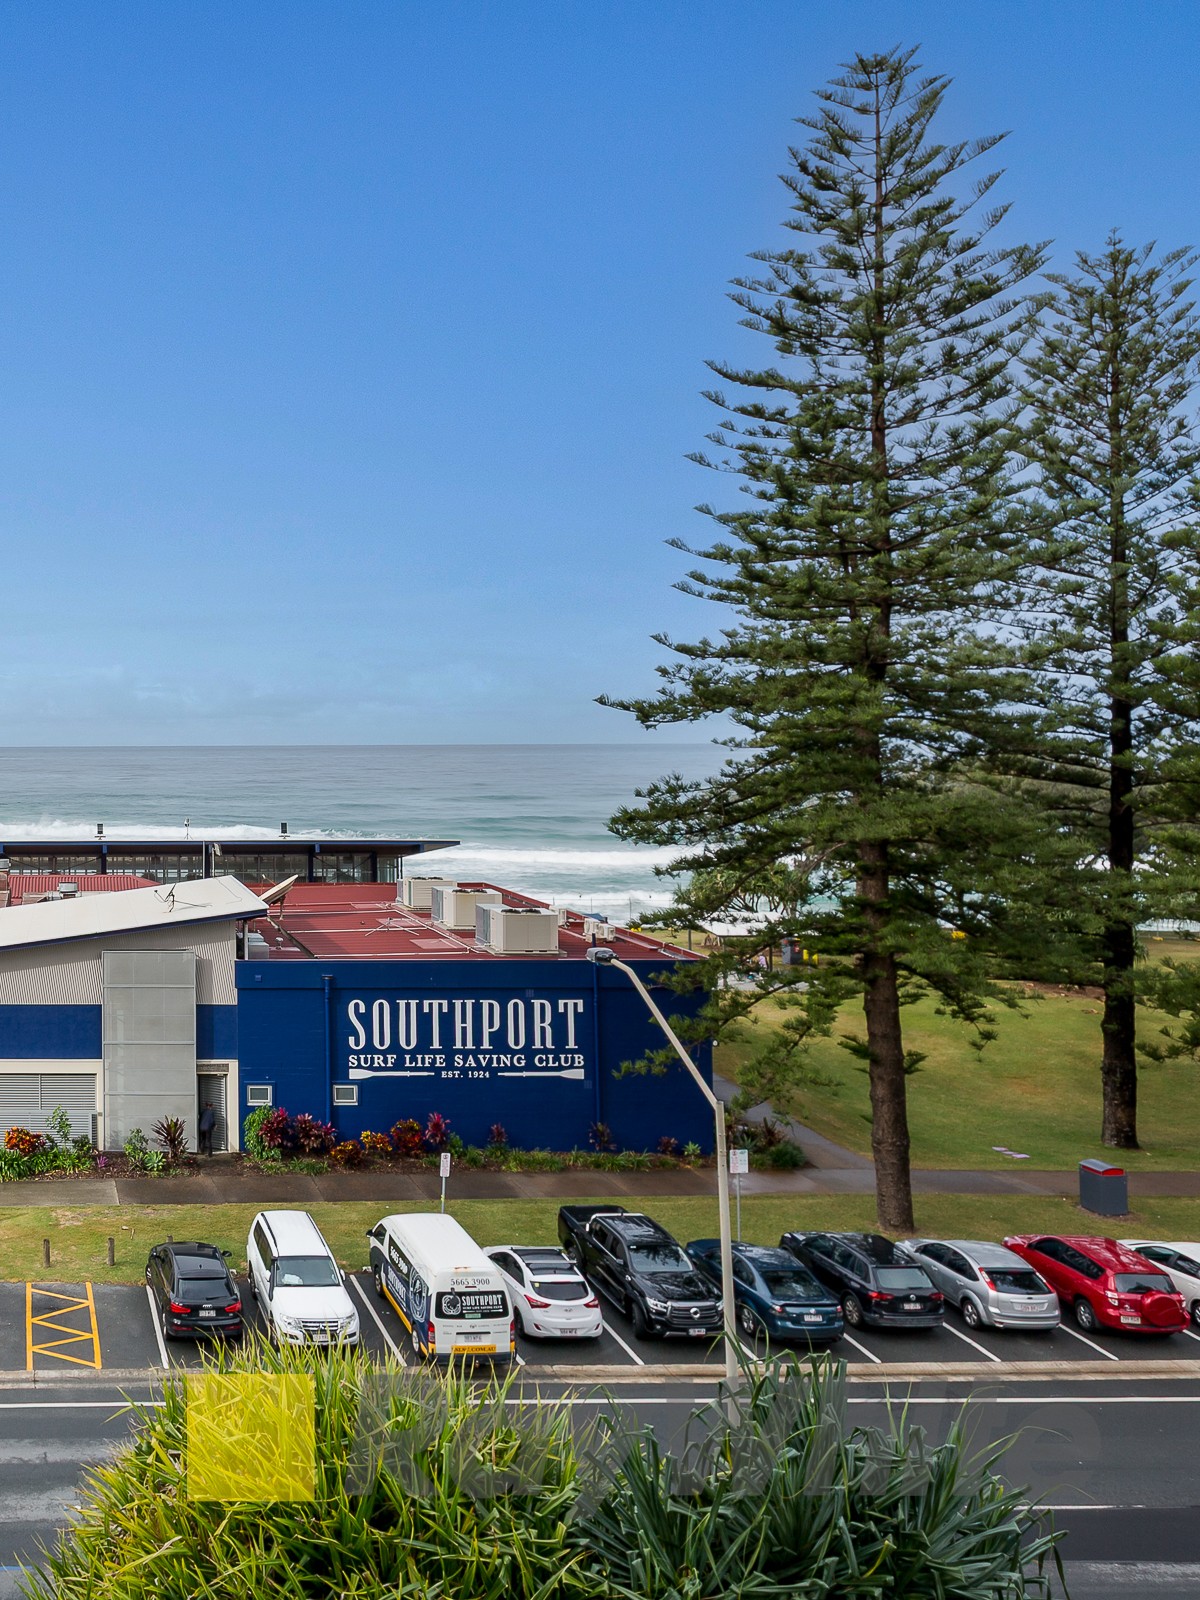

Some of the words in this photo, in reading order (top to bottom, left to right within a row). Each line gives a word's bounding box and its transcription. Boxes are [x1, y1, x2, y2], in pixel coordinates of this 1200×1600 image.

[347, 999, 584, 1050] SOUTHPORT
[348, 1054, 397, 1067] SURF
[404, 1054, 446, 1067] LIFE
[454, 1054, 526, 1067] SAVING
[534, 1054, 585, 1067] CLUB
[441, 1071, 464, 1079] EST.
[468, 1071, 490, 1079] 1924
[450, 1278, 470, 1286] 5665
[471, 1278, 490, 1286] 3900
[461, 1294, 503, 1306] SOUTHPORT
